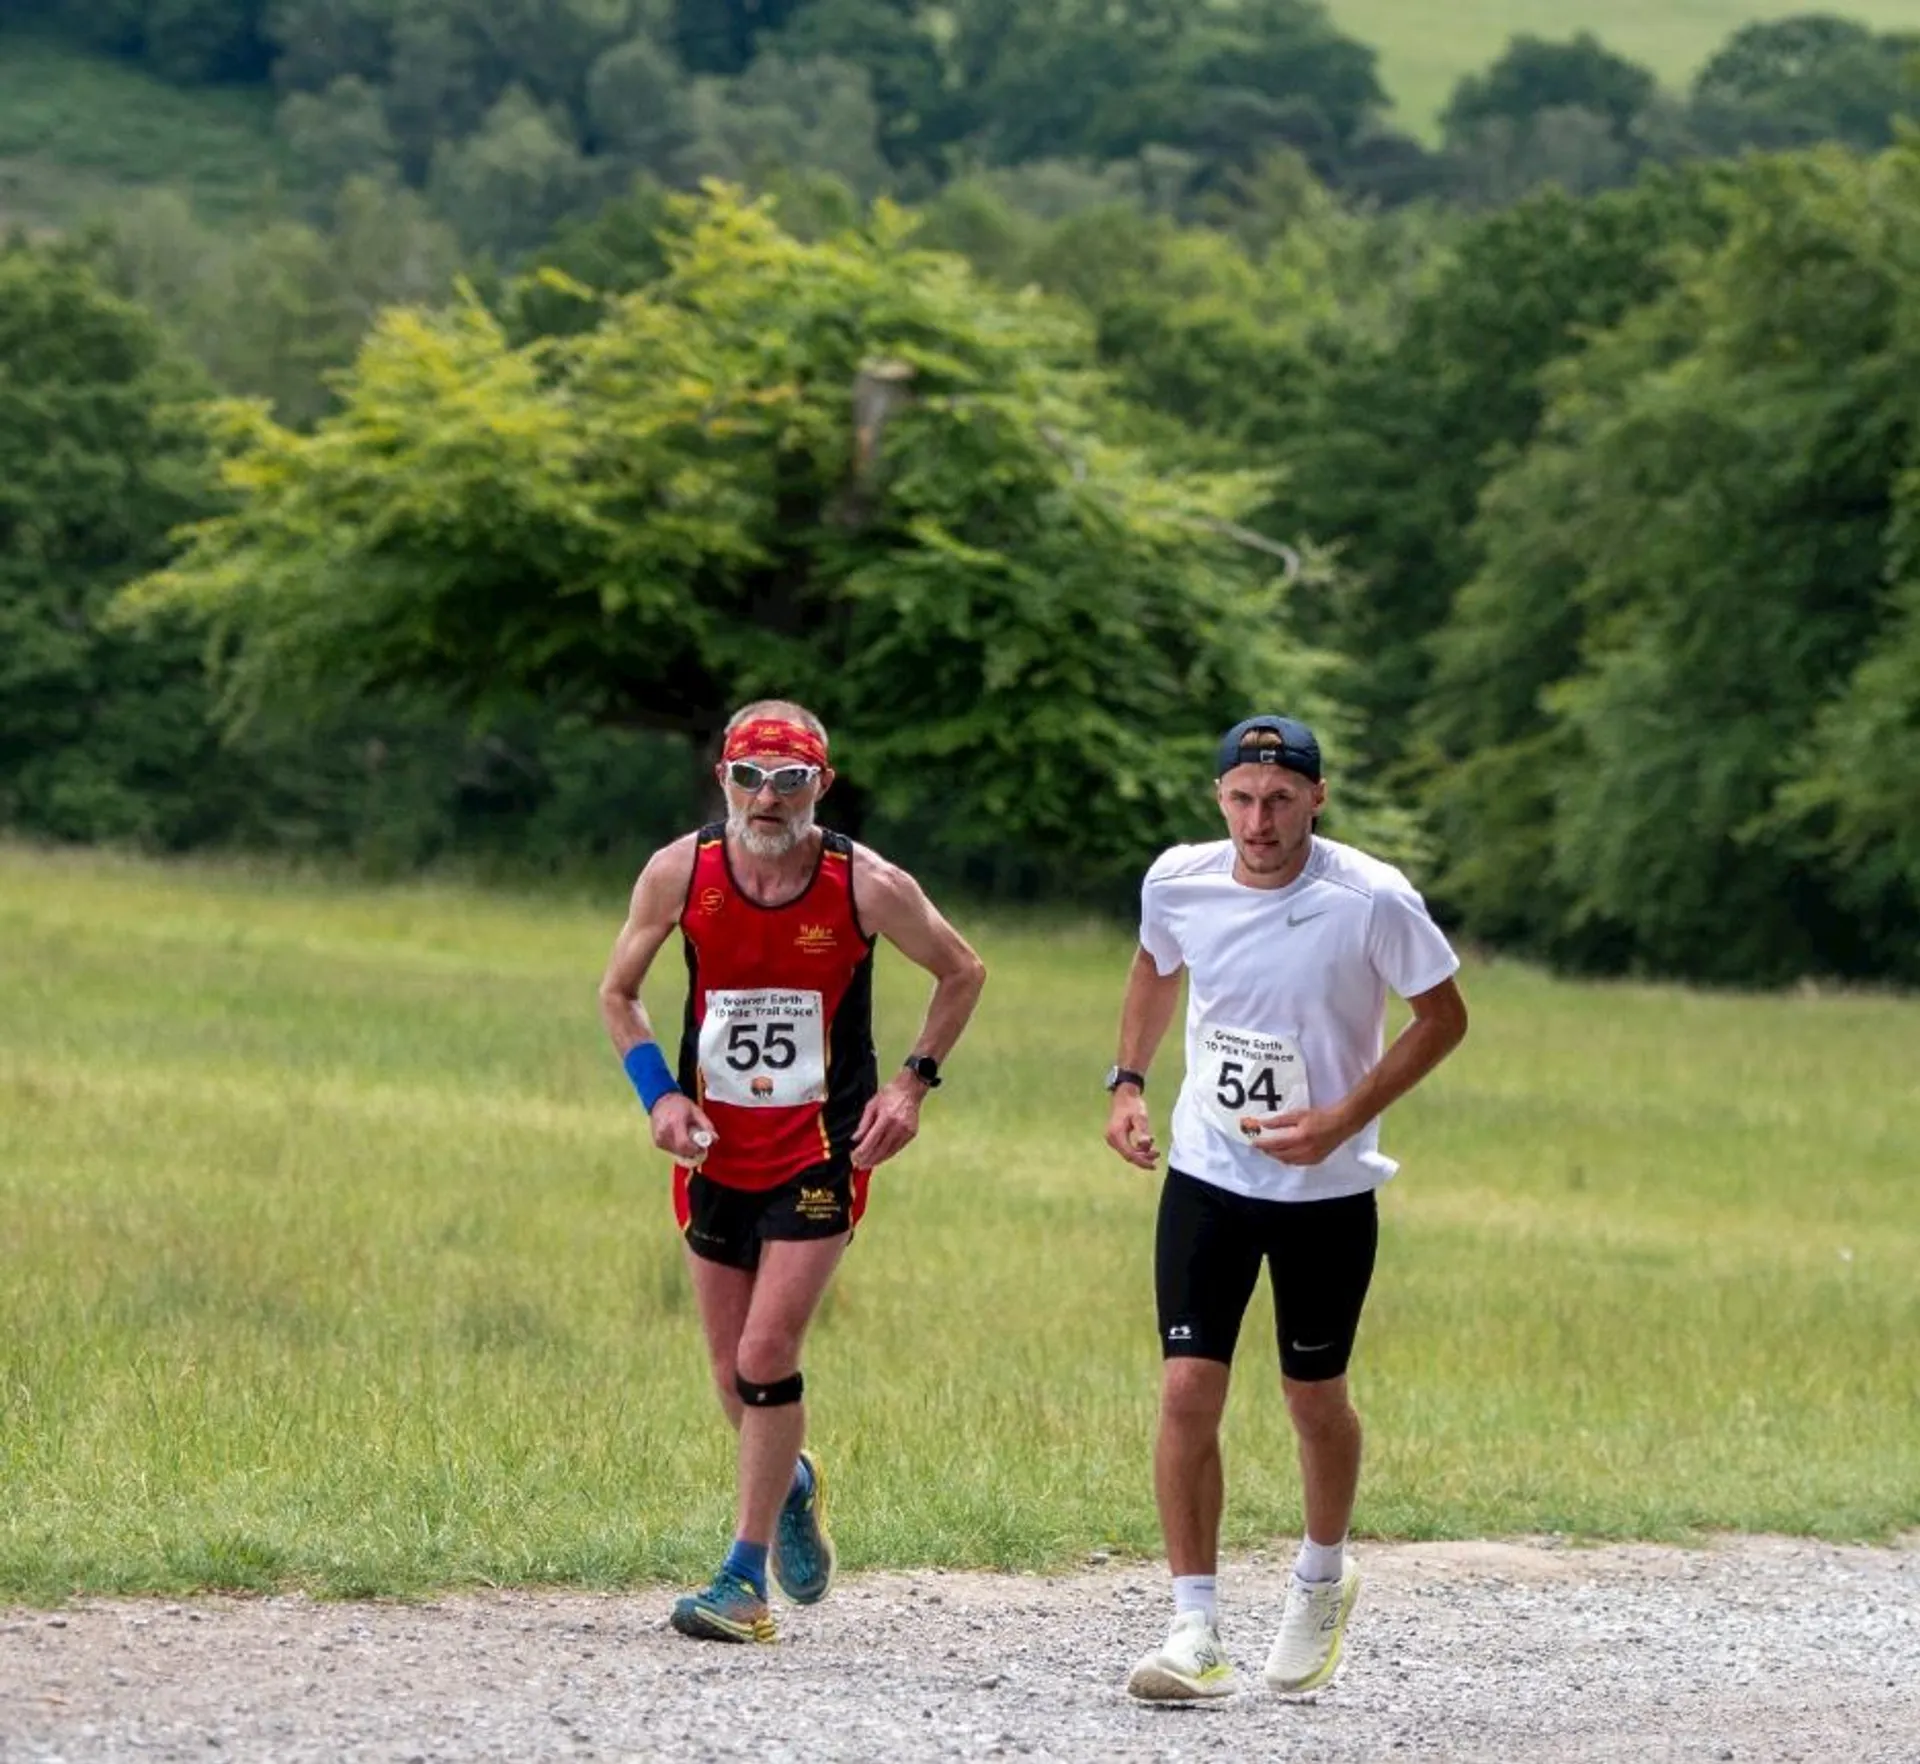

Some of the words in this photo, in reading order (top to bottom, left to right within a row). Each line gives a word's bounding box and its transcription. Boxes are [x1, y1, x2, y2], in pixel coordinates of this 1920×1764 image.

[756, 1006, 780, 1016] Trail
[770, 993, 802, 1005] Earth
[725, 1022, 796, 1071] 55
[1217, 1061, 1282, 1112] 54
